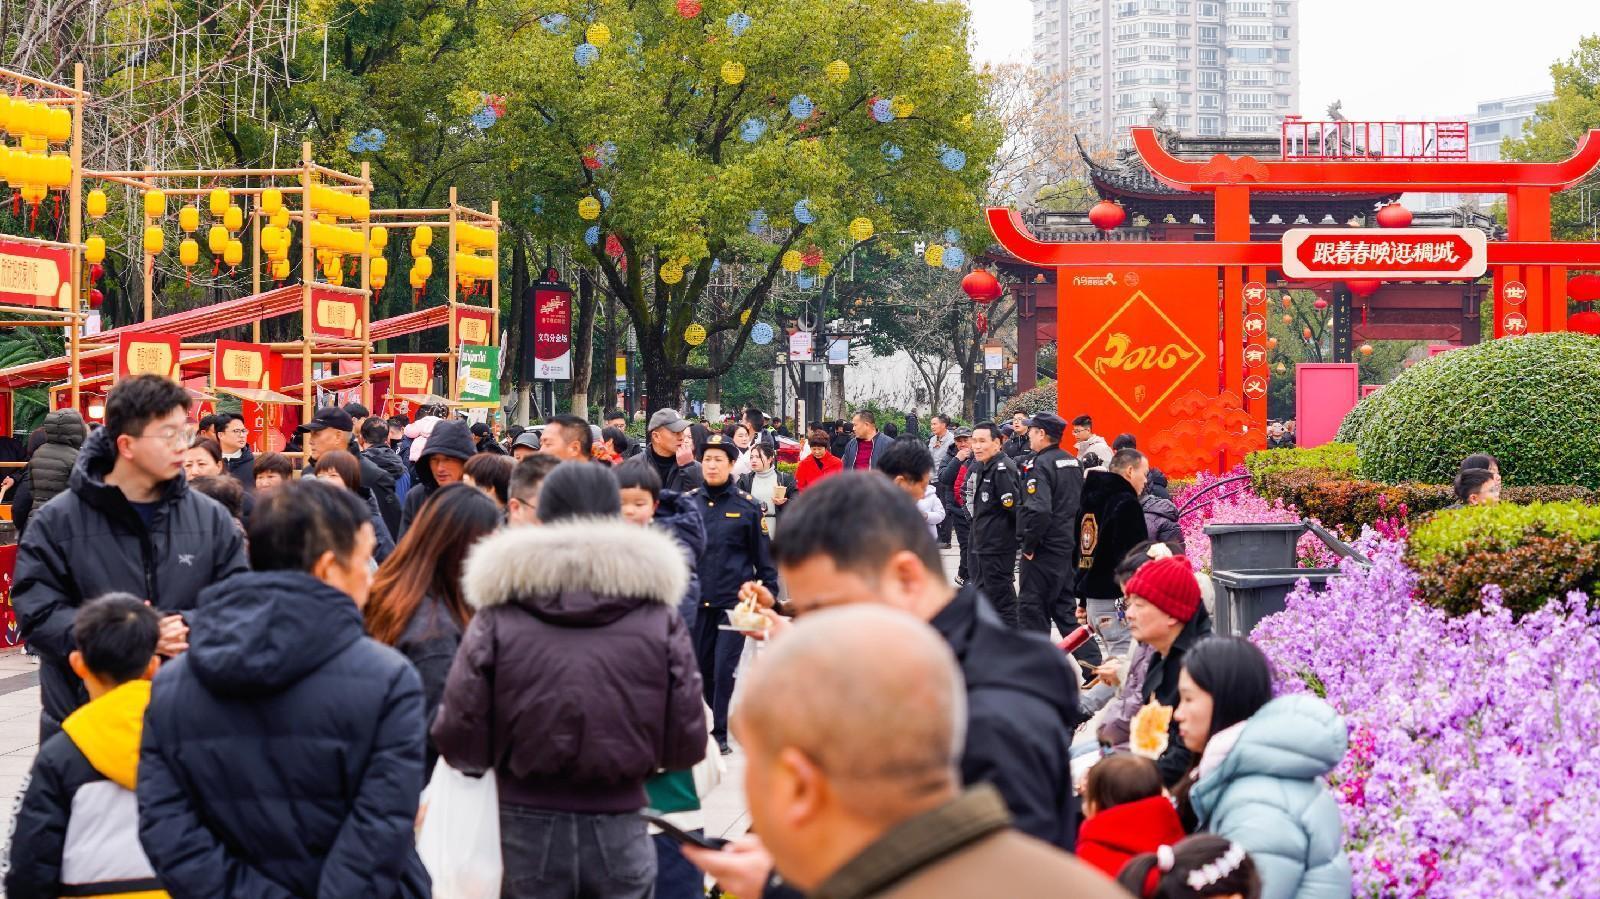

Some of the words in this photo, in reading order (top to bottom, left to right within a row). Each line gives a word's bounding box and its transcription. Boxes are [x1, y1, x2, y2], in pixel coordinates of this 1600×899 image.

[1312, 240, 1461, 264] 跟着春晚逛稠城
[1504, 286, 1525, 332] 世界
[1245, 287, 1265, 393] 有情有义
